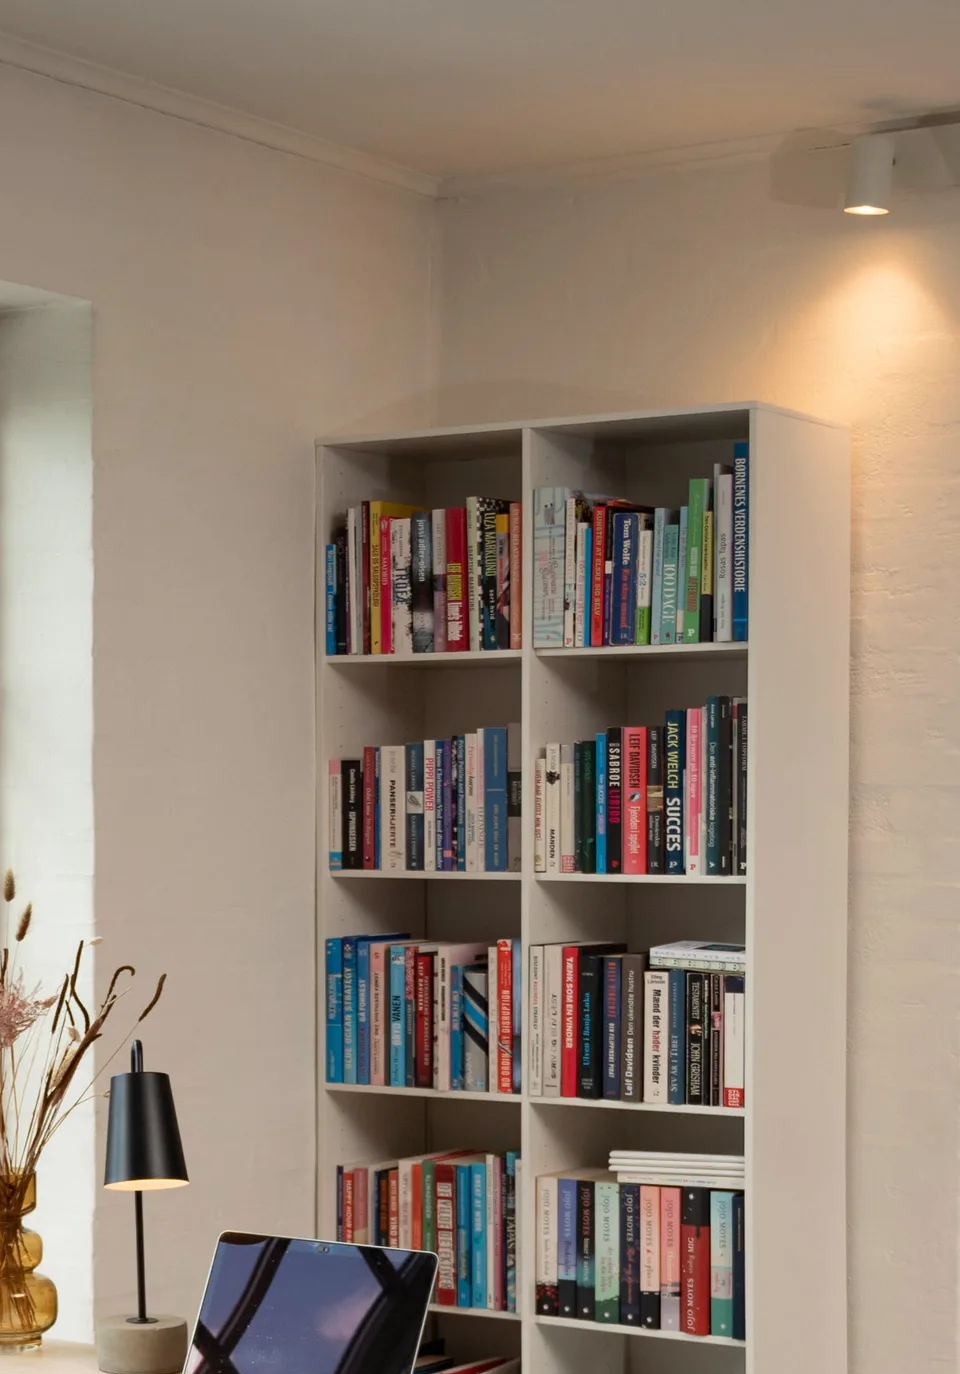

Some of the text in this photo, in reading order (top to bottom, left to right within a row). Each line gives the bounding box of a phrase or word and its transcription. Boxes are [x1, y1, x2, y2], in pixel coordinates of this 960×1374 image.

[484, 512, 496, 530] LIZA
[596, 510, 604, 545] KUNSTEN
[623, 518, 631, 538] Tom
[734, 458, 746, 593] BØRNENES VERDENSHISTORIE
[416, 519, 427, 582] jussi adler-olsen
[484, 532, 496, 577] MARKLUND
[595, 547, 603, 556] AT
[622, 540, 631, 565] Wolfe
[719, 533, 727, 554] Tapas
[594, 558, 602, 581] ELSKE
[394, 567, 409, 605] TROFÆ
[662, 563, 676, 624] 100 DAGE
[629, 734, 640, 750] LEIF
[425, 758, 434, 780] PIPPI
[629, 751, 640, 789] DAVIDSEN
[425, 782, 434, 811] POWER
[609, 748, 620, 824] SABROE LIBIDO
[666, 722, 681, 852] JACK WELCH SUCCES
[627, 806, 640, 829] Fjenden
[348, 811, 356, 851] ISPRINSESSEN
[708, 822, 716, 847] kogebog
[627, 834, 639, 854] spejlet
[344, 967, 352, 1012] STRATEGY
[627, 970, 635, 992] hustru
[391, 995, 401, 1022] VANEN
[501, 990, 511, 1033] DISRUPTION
[565, 957, 574, 1049] TÆNK SOM EN VINDER
[627, 994, 635, 1021] ukendte
[583, 1013, 591, 1036] Banja
[652, 989, 662, 1084] Mænd der hader kvinder
[551, 1039, 557, 1052] OG
[690, 982, 701, 1096] TESTAMENTET JOHN GRISHAM
[625, 1038, 634, 1078] Davidsen
[501, 1078, 511, 1088] NO
[625, 1079, 633, 1096] Leif
[542, 1189, 550, 1207] JOJO
[563, 1190, 571, 1209] JOJO
[582, 1188, 590, 1206] JOJO
[601, 1194, 610, 1214] JOJO
[625, 1194, 633, 1213] JOJO
[644, 1199, 652, 1218] JOJO
[665, 1199, 674, 1218] JOJO
[717, 1200, 727, 1219] JOJO
[437, 1182, 454, 1289] DE VILDE DETEKTIVER
[507, 1216, 516, 1249] TAPAS
[687, 1309, 695, 1331] JOJO
